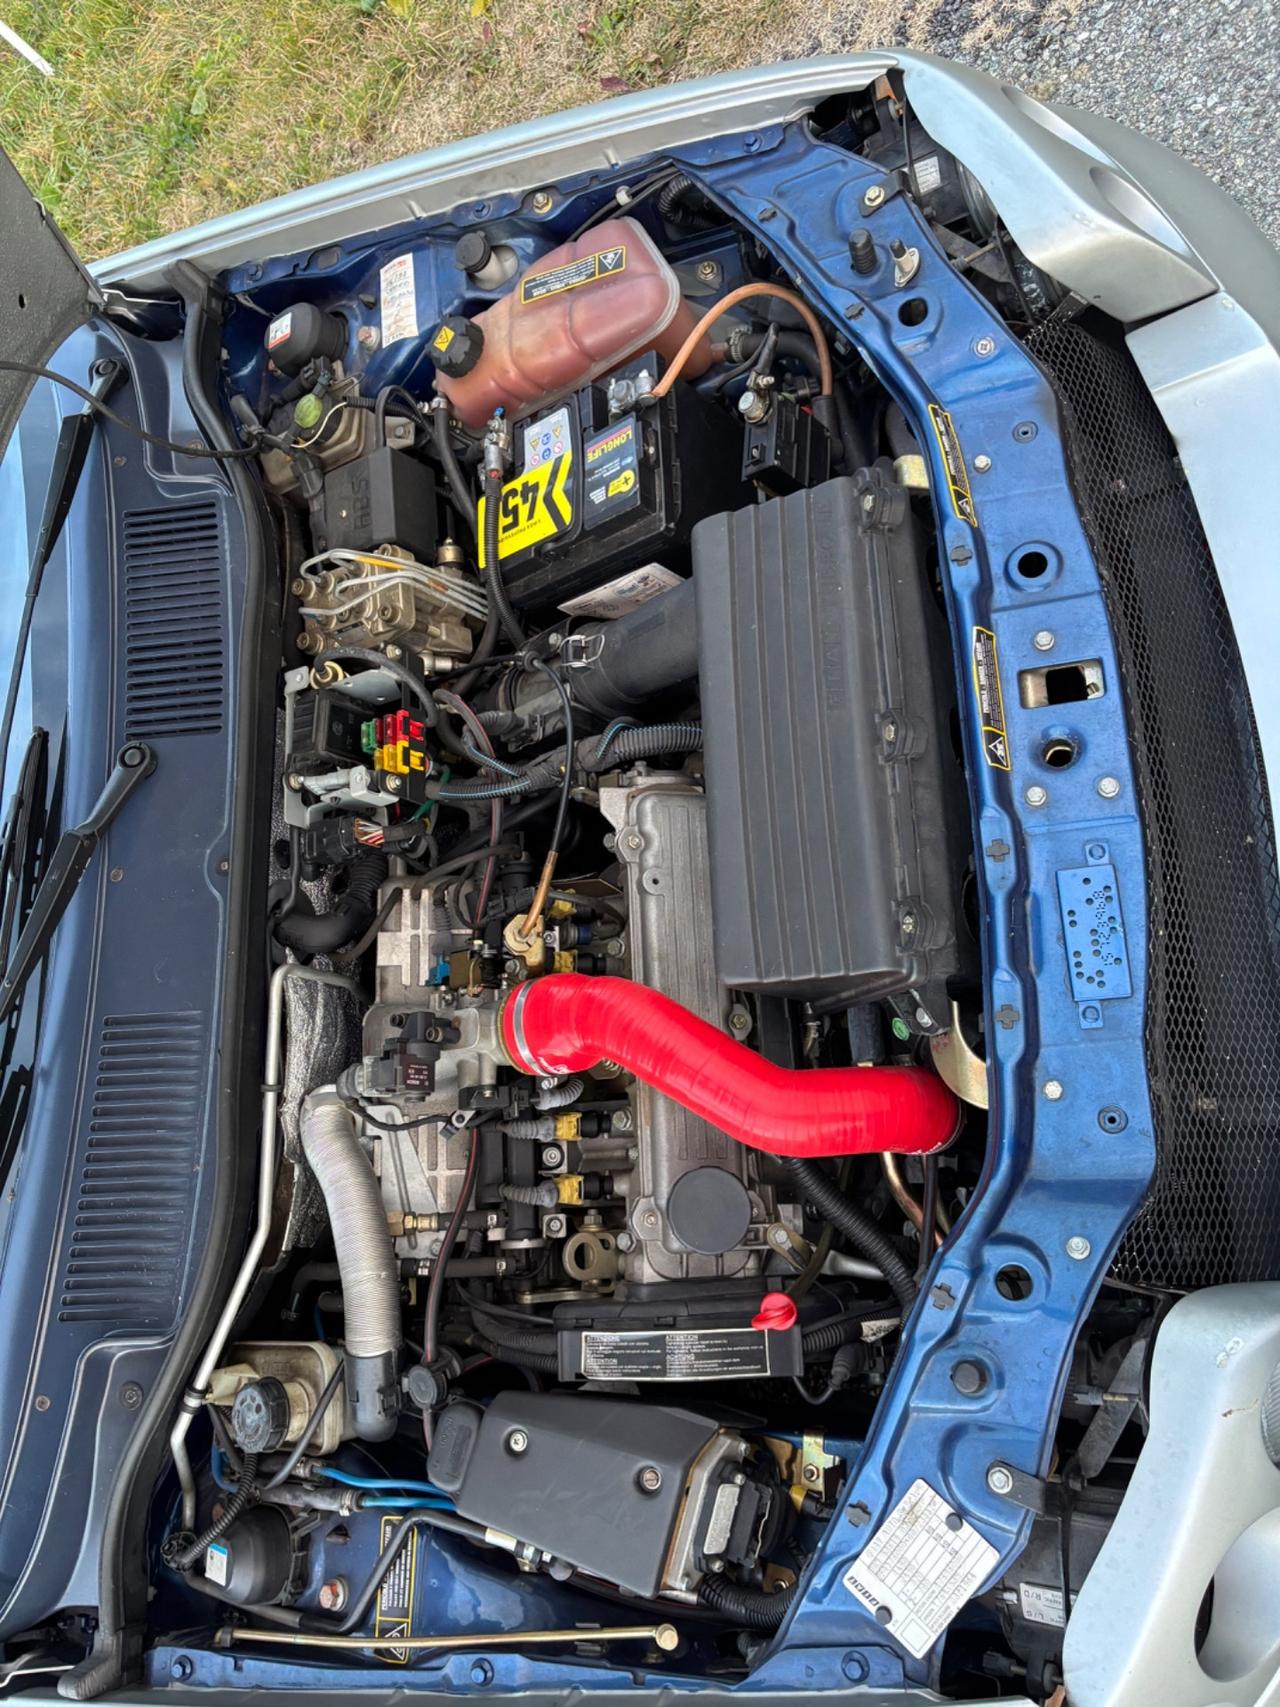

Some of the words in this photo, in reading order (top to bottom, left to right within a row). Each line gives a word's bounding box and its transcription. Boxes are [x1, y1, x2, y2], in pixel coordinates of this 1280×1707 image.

[585, 429, 632, 462] LONGLIFE
[502, 480, 538, 533] 45
[846, 1574, 879, 1606] FIAT
